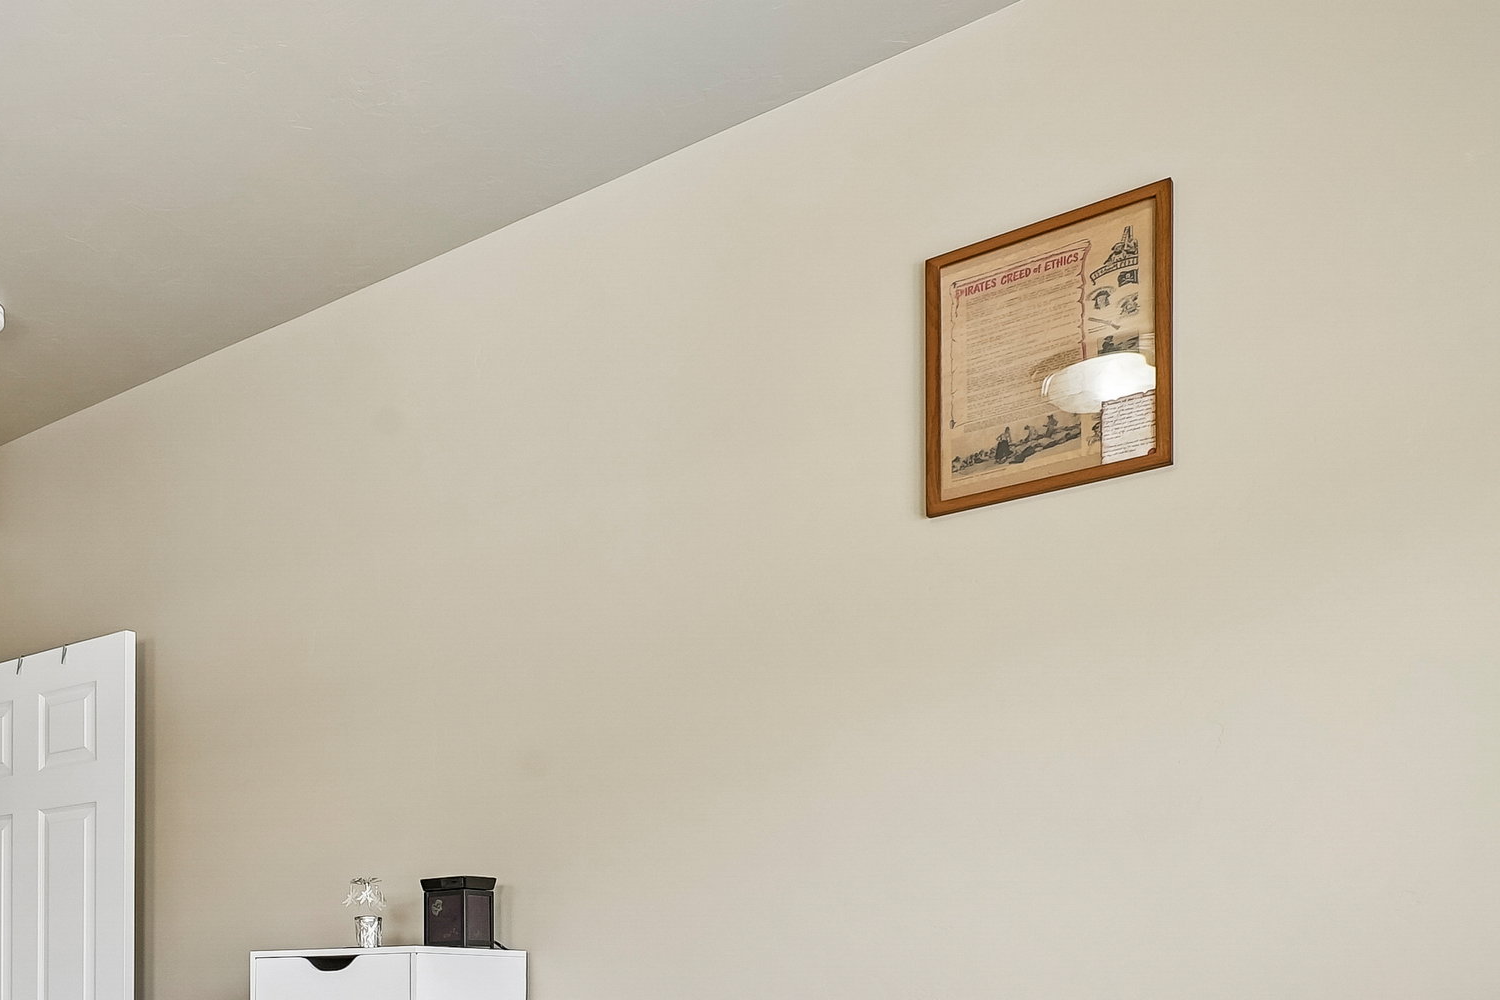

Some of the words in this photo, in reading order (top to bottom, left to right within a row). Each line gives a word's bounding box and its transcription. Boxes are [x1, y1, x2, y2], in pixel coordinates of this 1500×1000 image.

[955, 278, 997, 298] PIRATES
[1000, 267, 1031, 285] CREED
[1033, 264, 1042, 274] of
[1044, 252, 1079, 272] ETHICS
